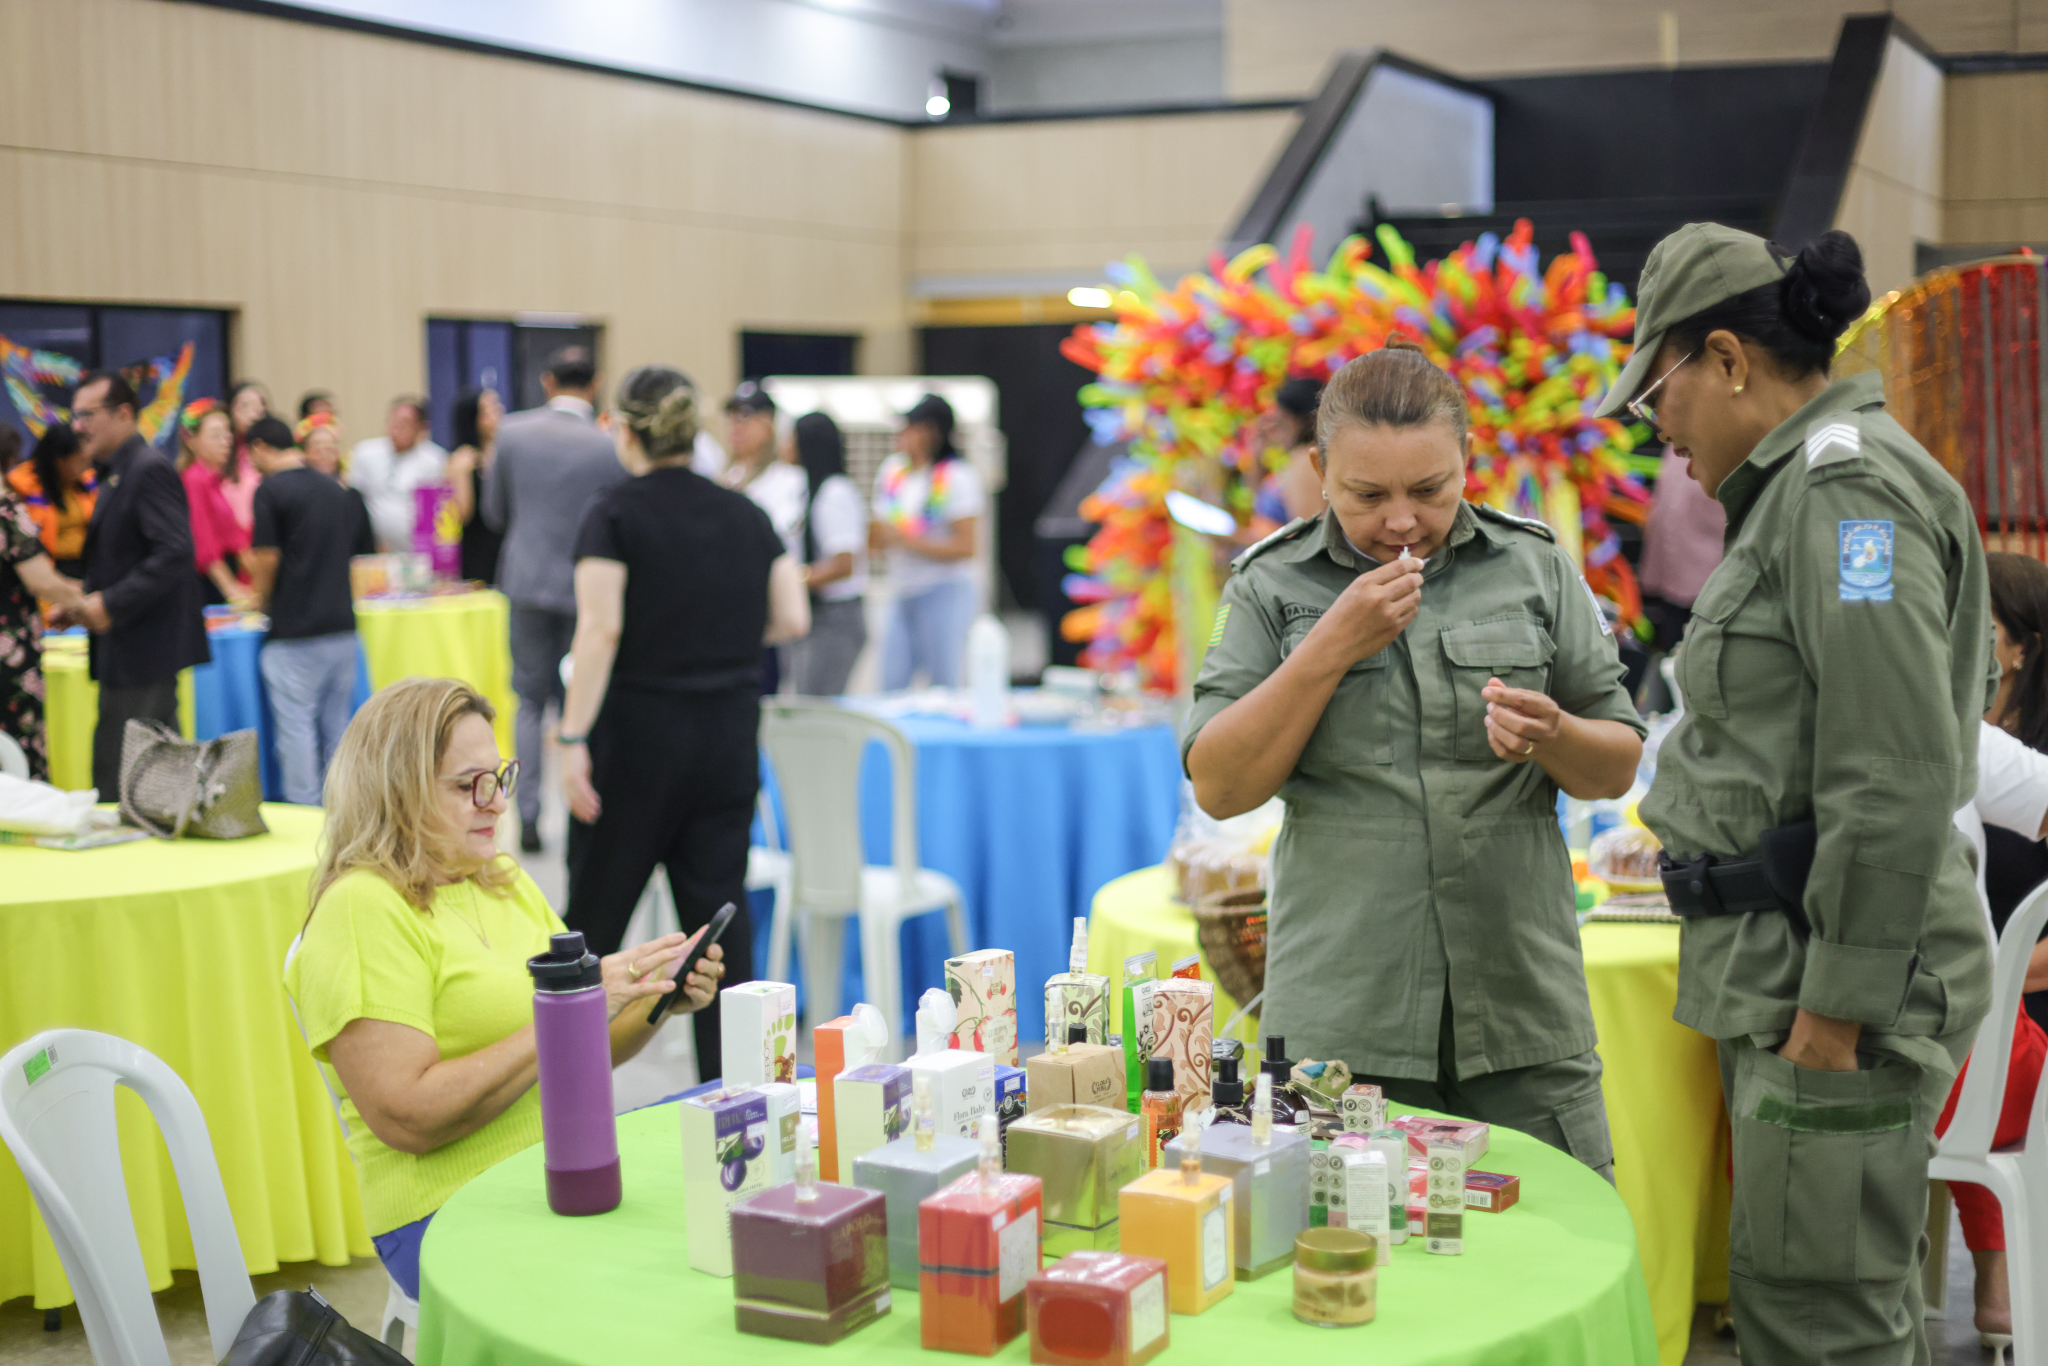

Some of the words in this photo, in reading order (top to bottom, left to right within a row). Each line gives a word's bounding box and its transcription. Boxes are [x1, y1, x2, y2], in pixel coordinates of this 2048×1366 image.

[1286, 606, 1326, 617] PATRI
[953, 1110, 969, 1122] Flora
[970, 1104, 986, 1115] Baby
[781, 1134, 797, 1144] HELEN
